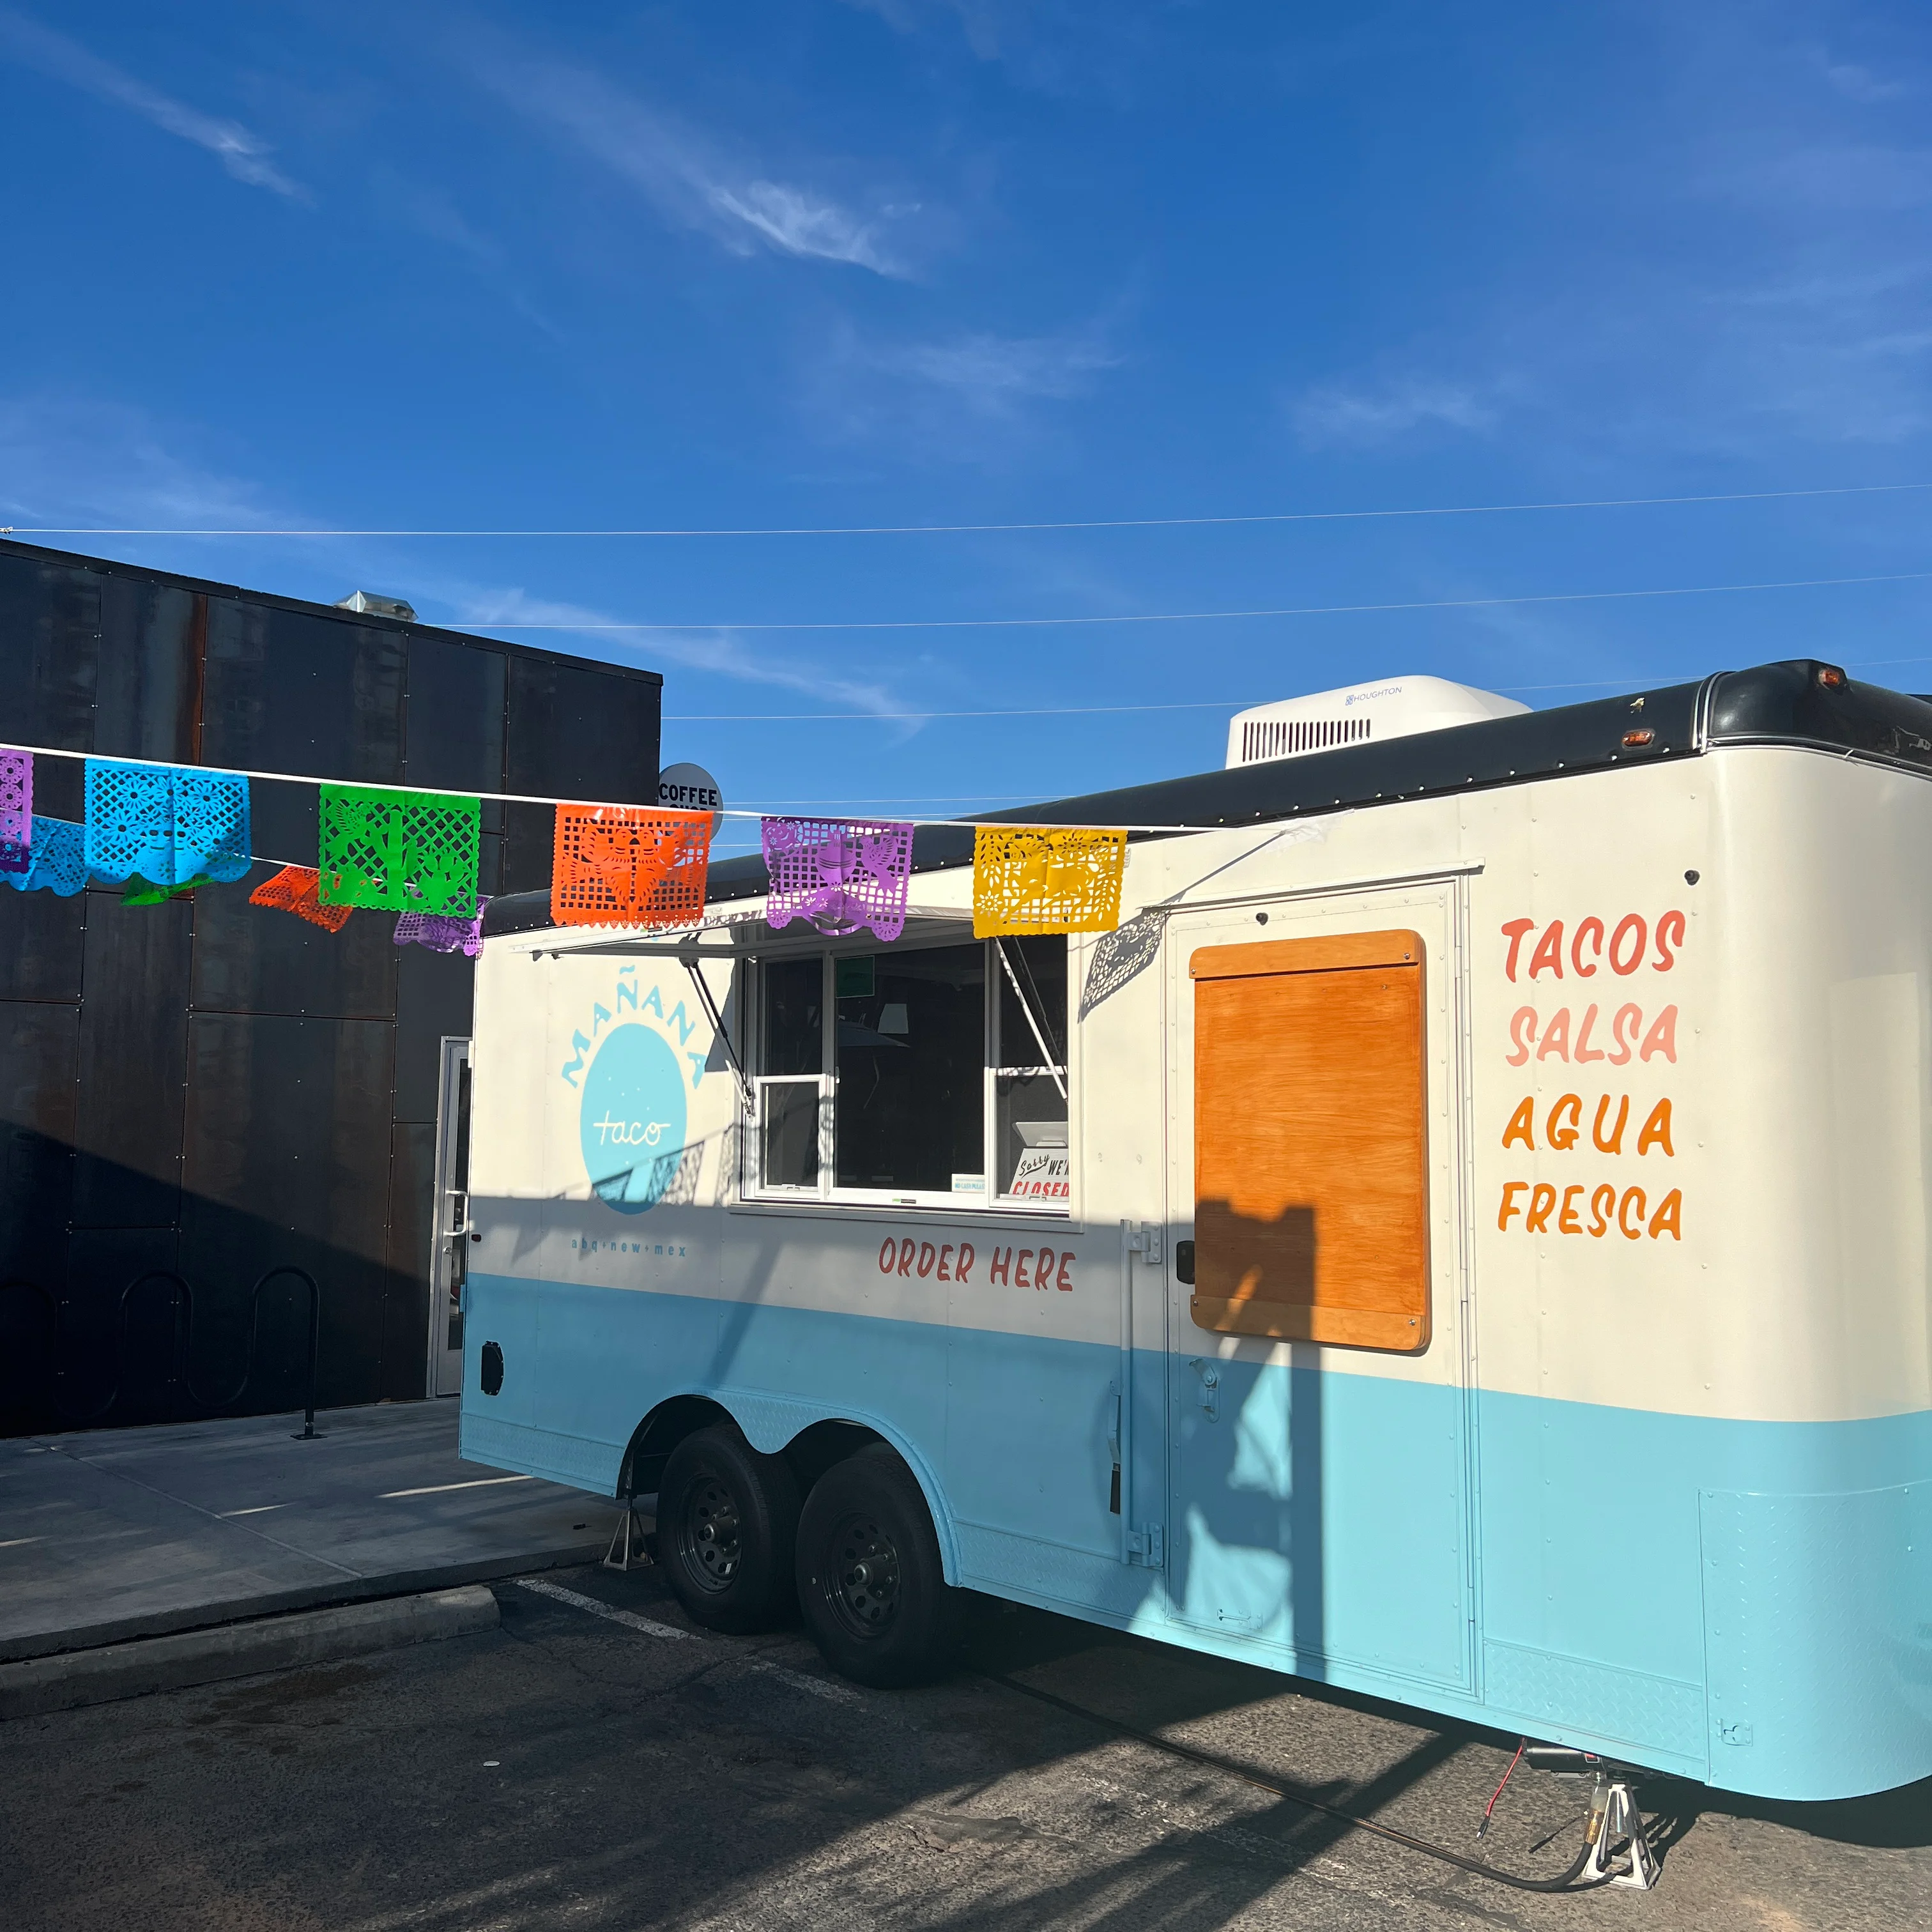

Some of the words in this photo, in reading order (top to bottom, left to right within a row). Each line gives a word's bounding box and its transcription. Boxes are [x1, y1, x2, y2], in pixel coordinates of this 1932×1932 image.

[1353, 687, 1402, 702] HOUGHTON
[659, 783, 717, 806] COFFEE
[1501, 910, 1685, 983] TACOS
[562, 965, 707, 1089] MAÑANA
[1506, 1002, 1678, 1066] SALSA
[593, 1110, 671, 1146] taco
[1501, 1093, 1675, 1157] AGUA
[1019, 1154, 1050, 1176] Sorry
[1498, 1181, 1682, 1241] FRESCA
[878, 1237, 975, 1284] ORDER
[990, 1246, 1076, 1292] HERE
